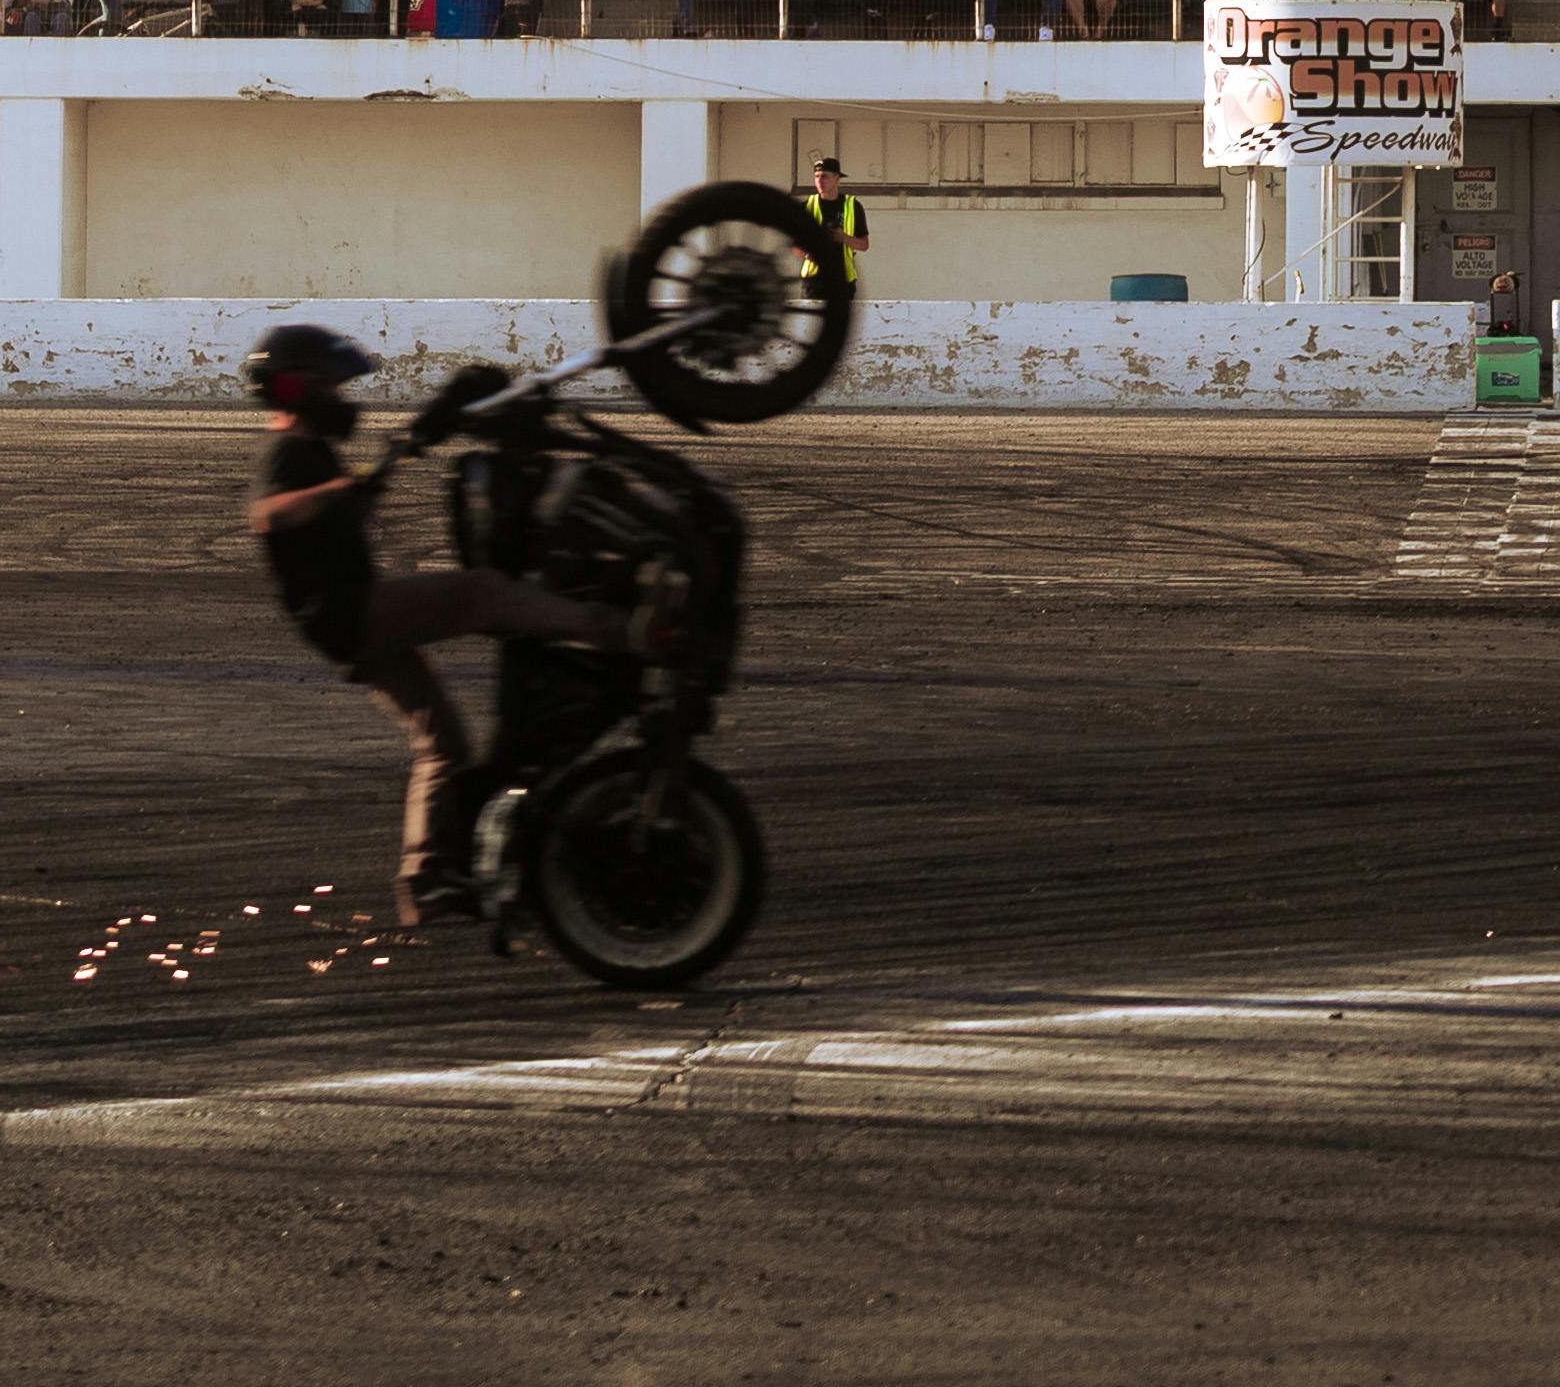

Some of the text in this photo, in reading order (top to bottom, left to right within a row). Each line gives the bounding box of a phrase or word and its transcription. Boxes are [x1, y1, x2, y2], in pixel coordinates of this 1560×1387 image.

[1217, 7, 1445, 70] Orange
[1290, 59, 1458, 118] Show
[1291, 120, 1457, 161] Speedway
[1455, 192, 1493, 201] VOAGE
[1455, 260, 1493, 269] VOLTAGE
[1462, 251, 1486, 261] ALTO
